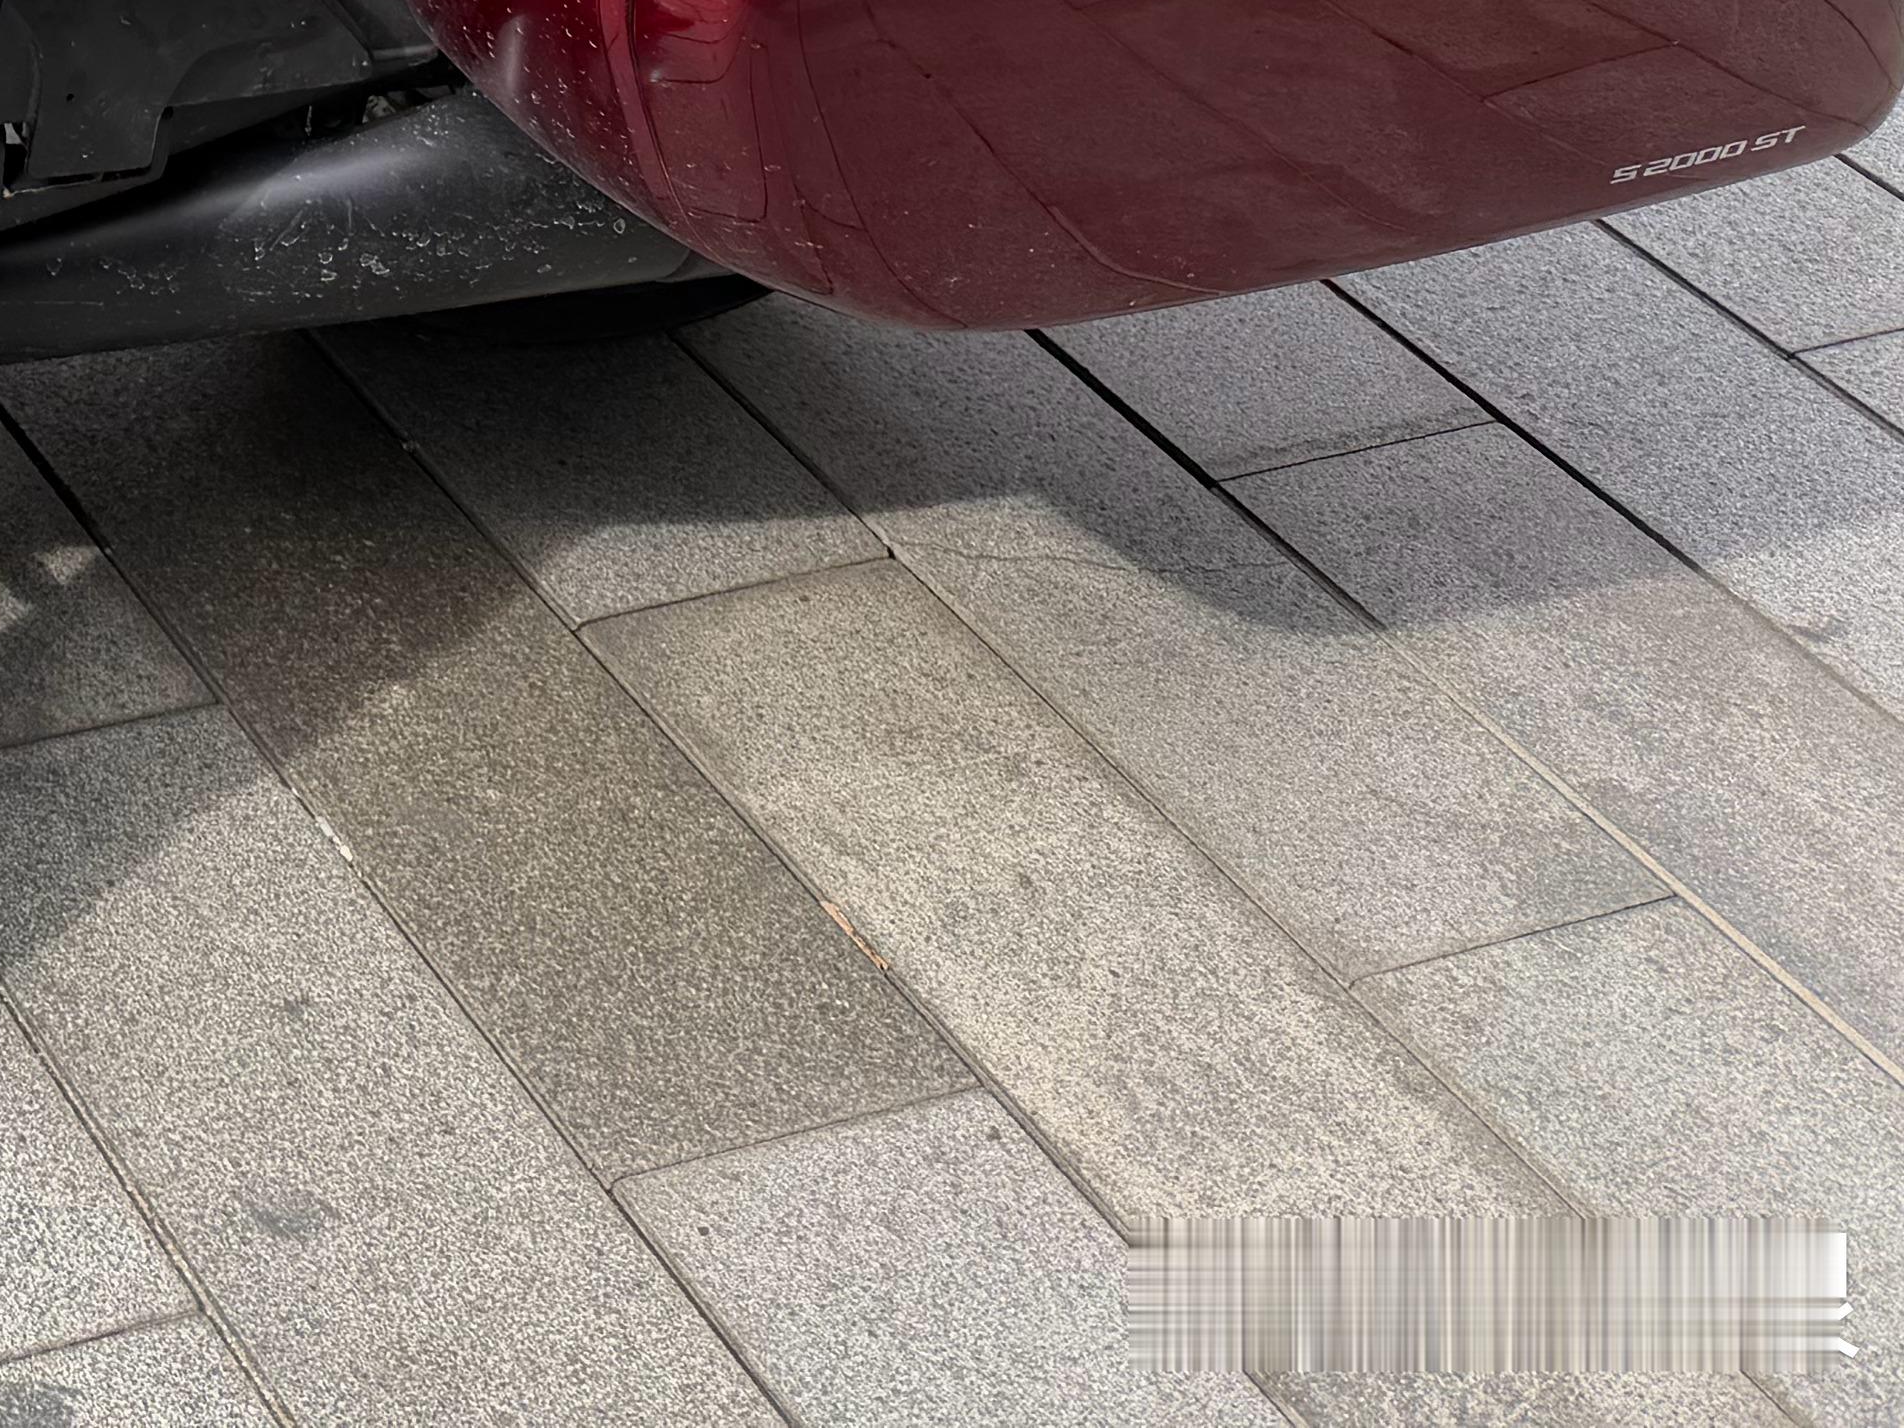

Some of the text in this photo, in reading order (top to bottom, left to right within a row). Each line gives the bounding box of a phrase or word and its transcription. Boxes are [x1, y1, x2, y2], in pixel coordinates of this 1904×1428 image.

[1610, 125, 1806, 185] S 2000 ST
